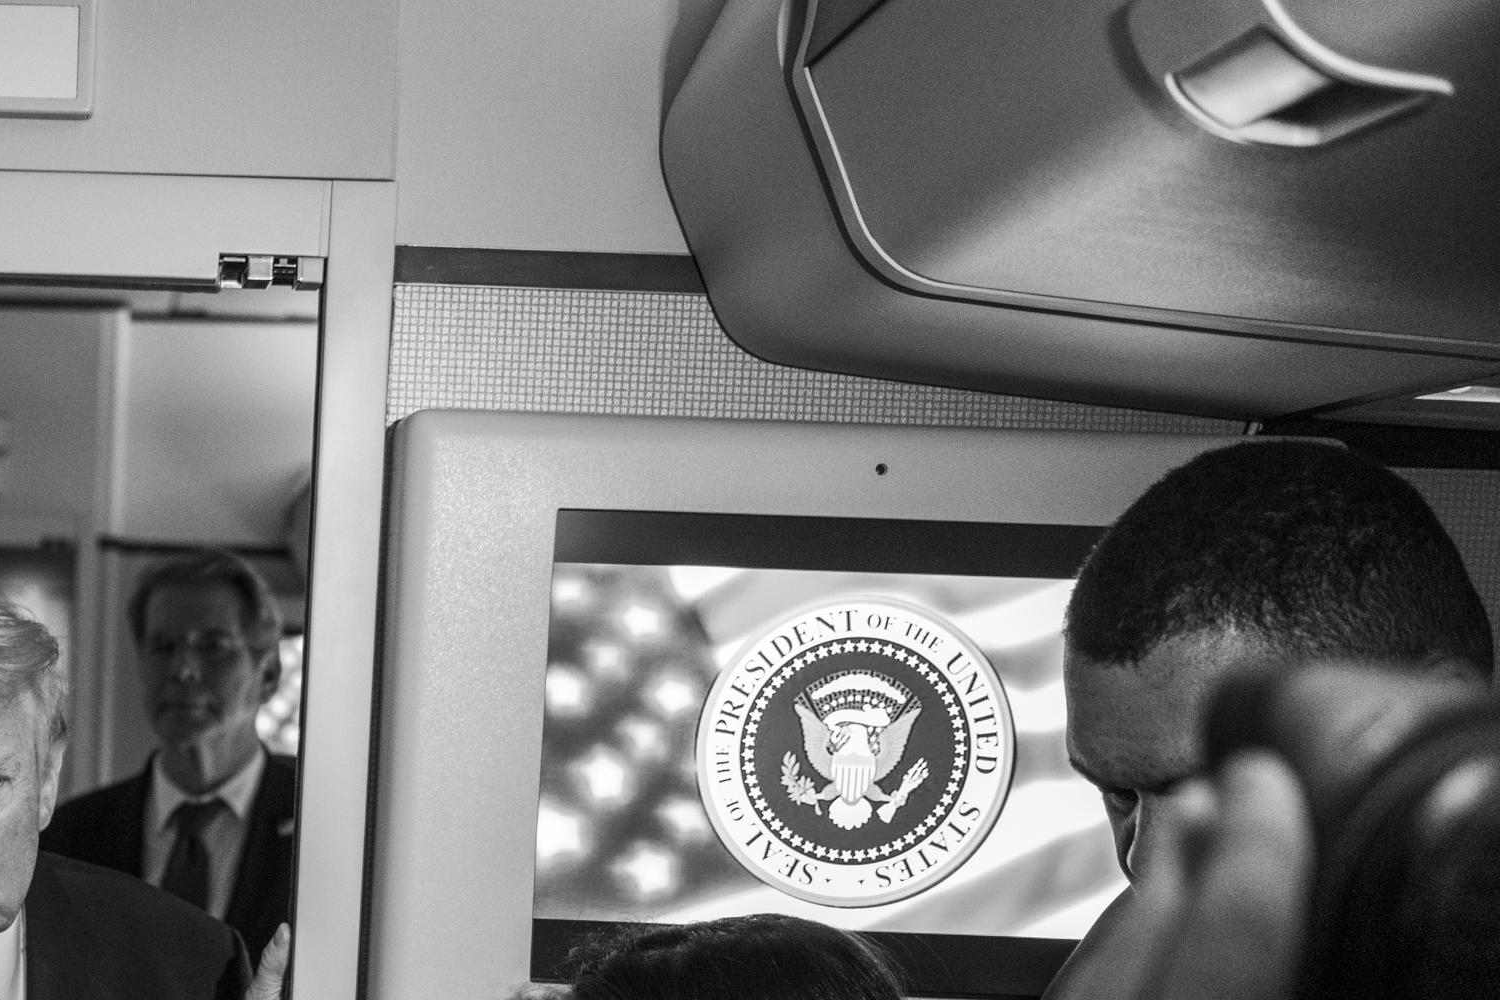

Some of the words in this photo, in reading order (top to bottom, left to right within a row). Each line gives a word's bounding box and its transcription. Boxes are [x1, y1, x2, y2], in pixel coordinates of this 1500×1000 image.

[866, 613, 897, 630] OF
[904, 621, 944, 653] THE
[714, 609, 858, 736] PRESIDENT
[946, 652, 999, 775] UNITED
[715, 744, 731, 784] THE
[723, 798, 745, 822] OF
[745, 823, 818, 885] SEAL
[874, 801, 981, 889] STATES
